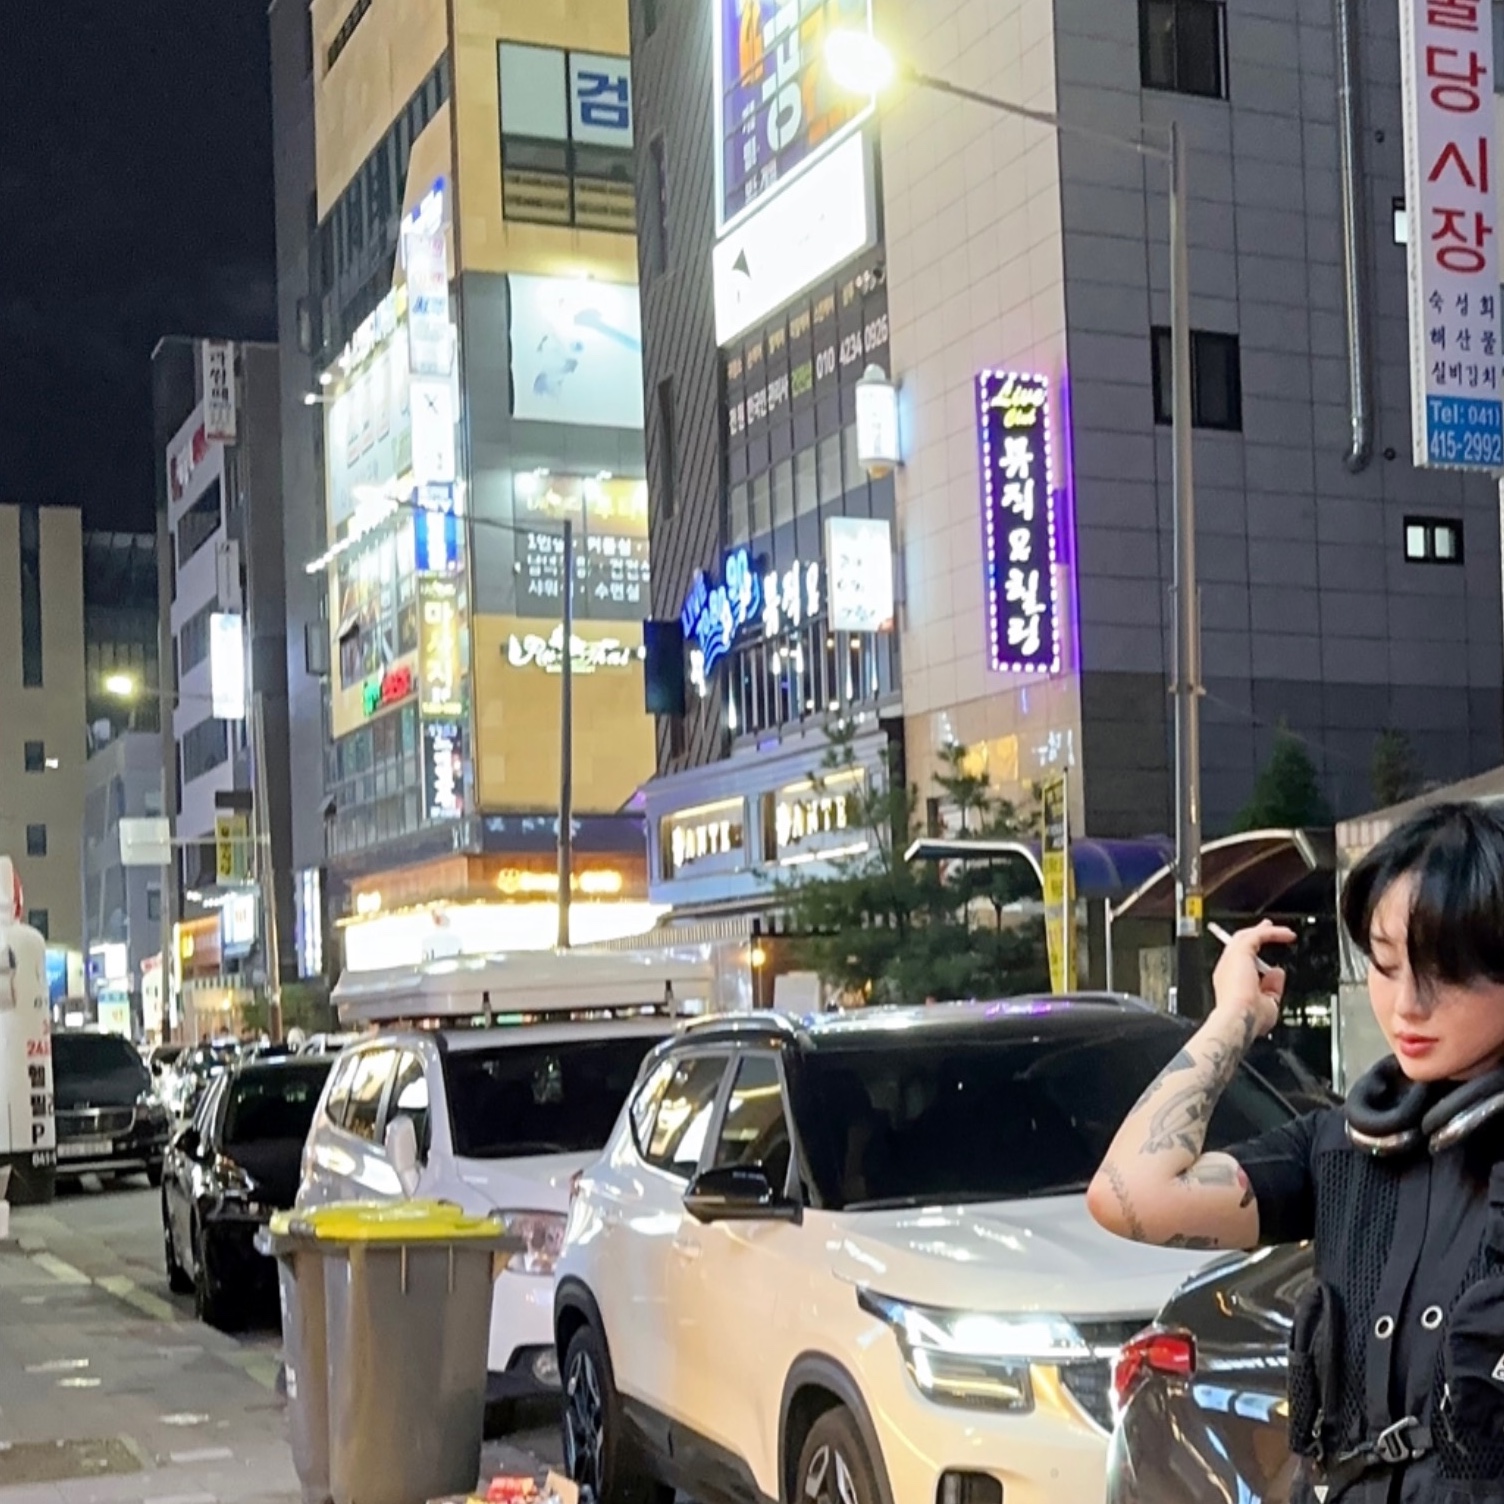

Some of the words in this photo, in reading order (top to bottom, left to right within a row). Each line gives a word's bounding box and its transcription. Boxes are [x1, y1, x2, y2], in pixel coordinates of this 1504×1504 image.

[1429, 289, 1495, 321] 숙성회
[1430, 325, 1496, 356] 해산물
[816, 346, 836, 380] 010
[1431, 360, 1497, 390] 실비김치
[1429, 401, 1464, 425] Tel:
[1468, 405, 1501, 428] 041)
[1430, 430, 1501, 463] 415-2992
